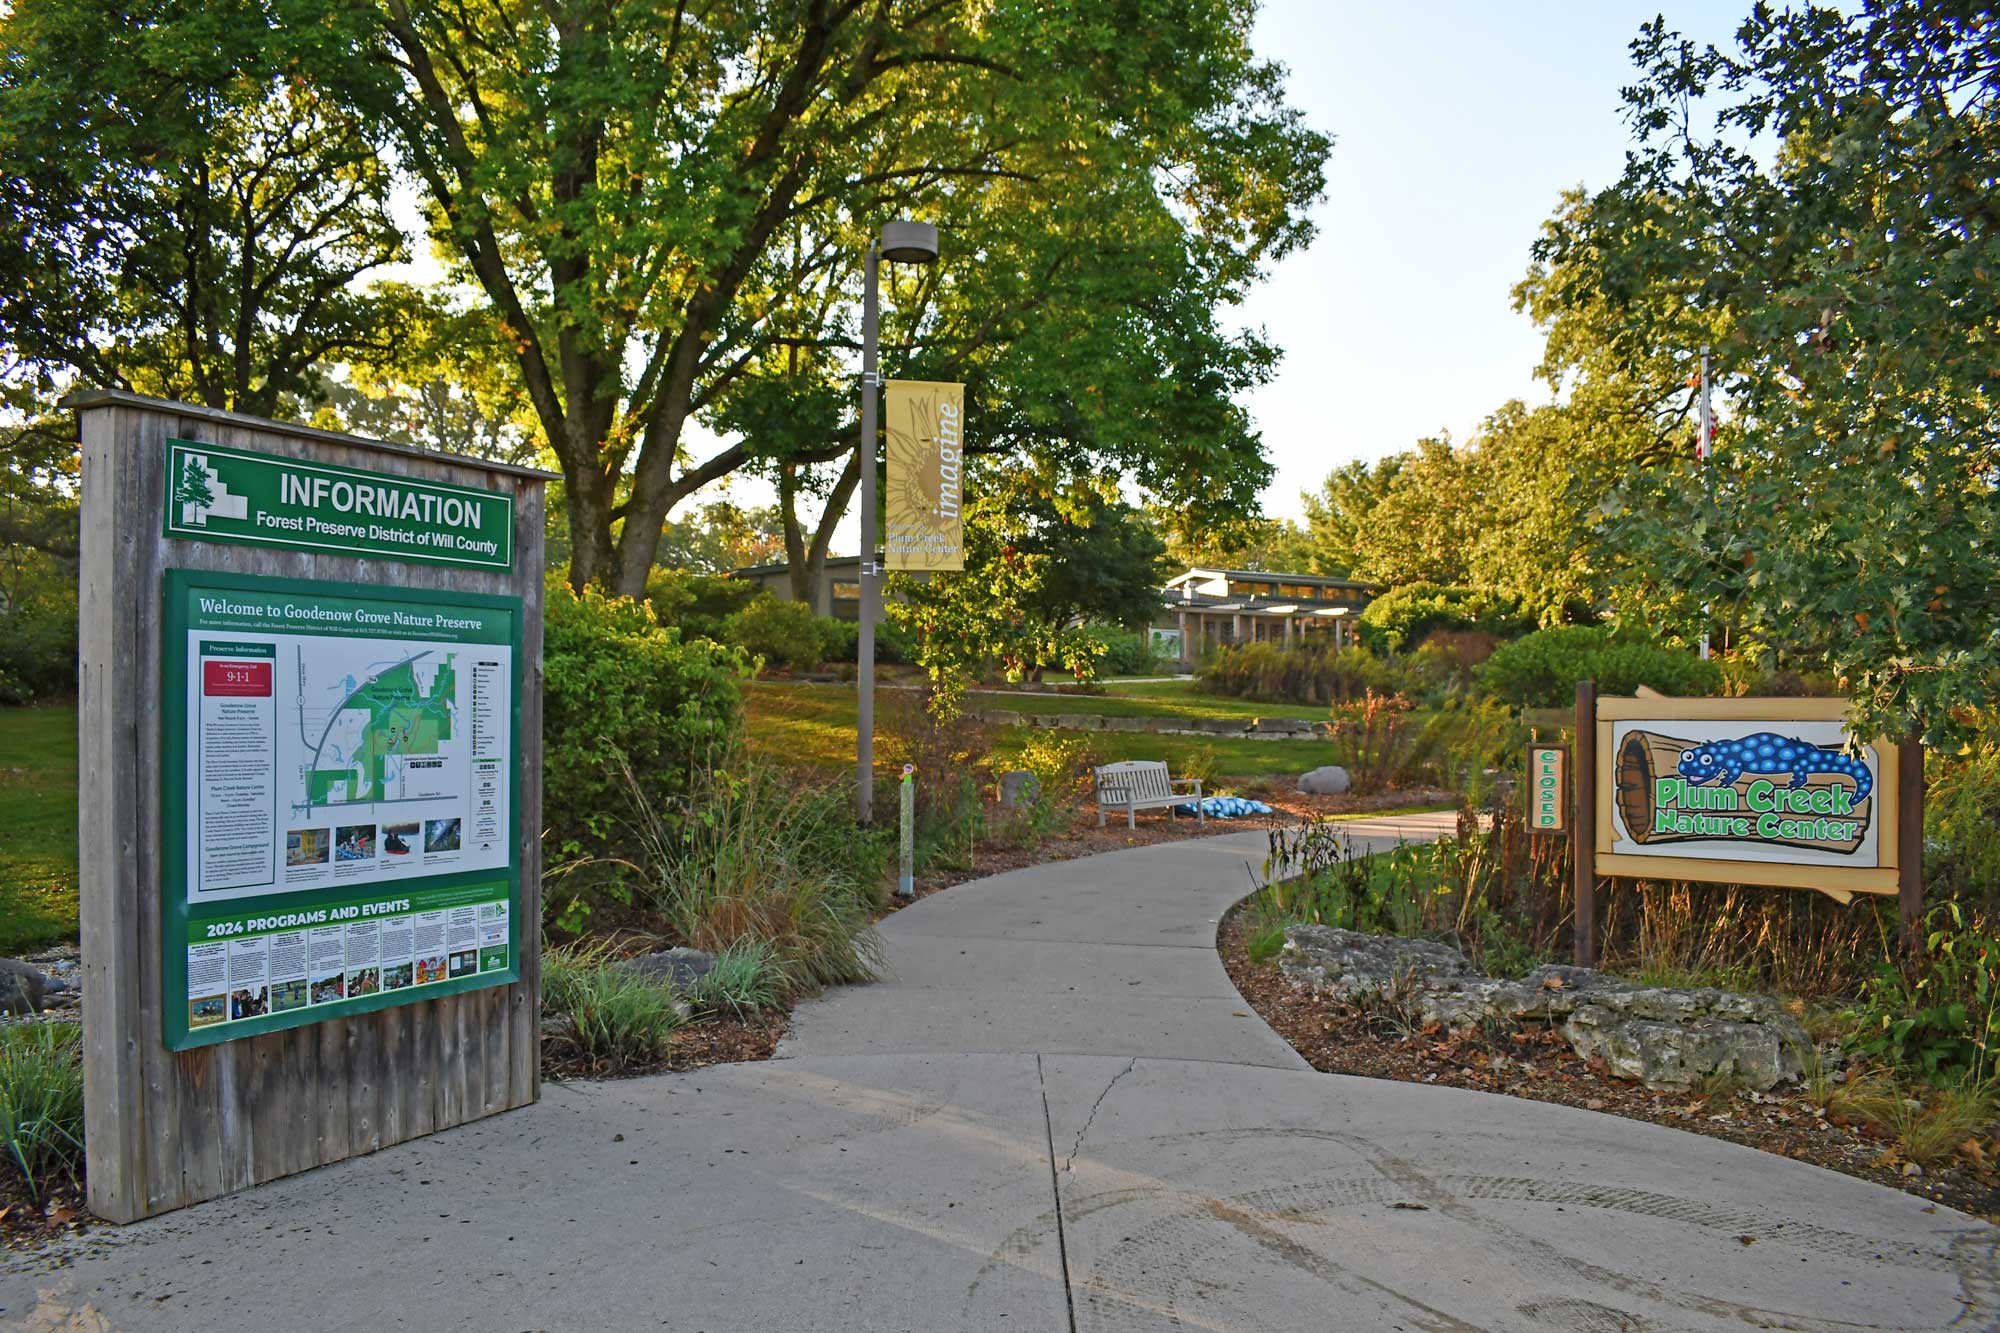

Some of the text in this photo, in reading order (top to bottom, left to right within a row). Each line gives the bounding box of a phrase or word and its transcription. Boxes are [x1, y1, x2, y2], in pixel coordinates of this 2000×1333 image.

[932, 403, 963, 520] imagine
[281, 473, 481, 529] INFORMATION
[256, 511, 498, 556] Forest Preserve District of Will County
[888, 533, 945, 542] Plum Creek
[888, 544, 958, 553] Nature Center
[200, 598, 482, 630] Welcome to Goodenow Grove Nature Preserve
[209, 644, 267, 654] Preserve Information
[1539, 750, 1557, 827] CLOSED
[1656, 778, 1856, 816] Plum Creek
[1655, 809, 1858, 841] Nature Center
[207, 899, 410, 937] 2024 PROGRAMS AND EVENTS
